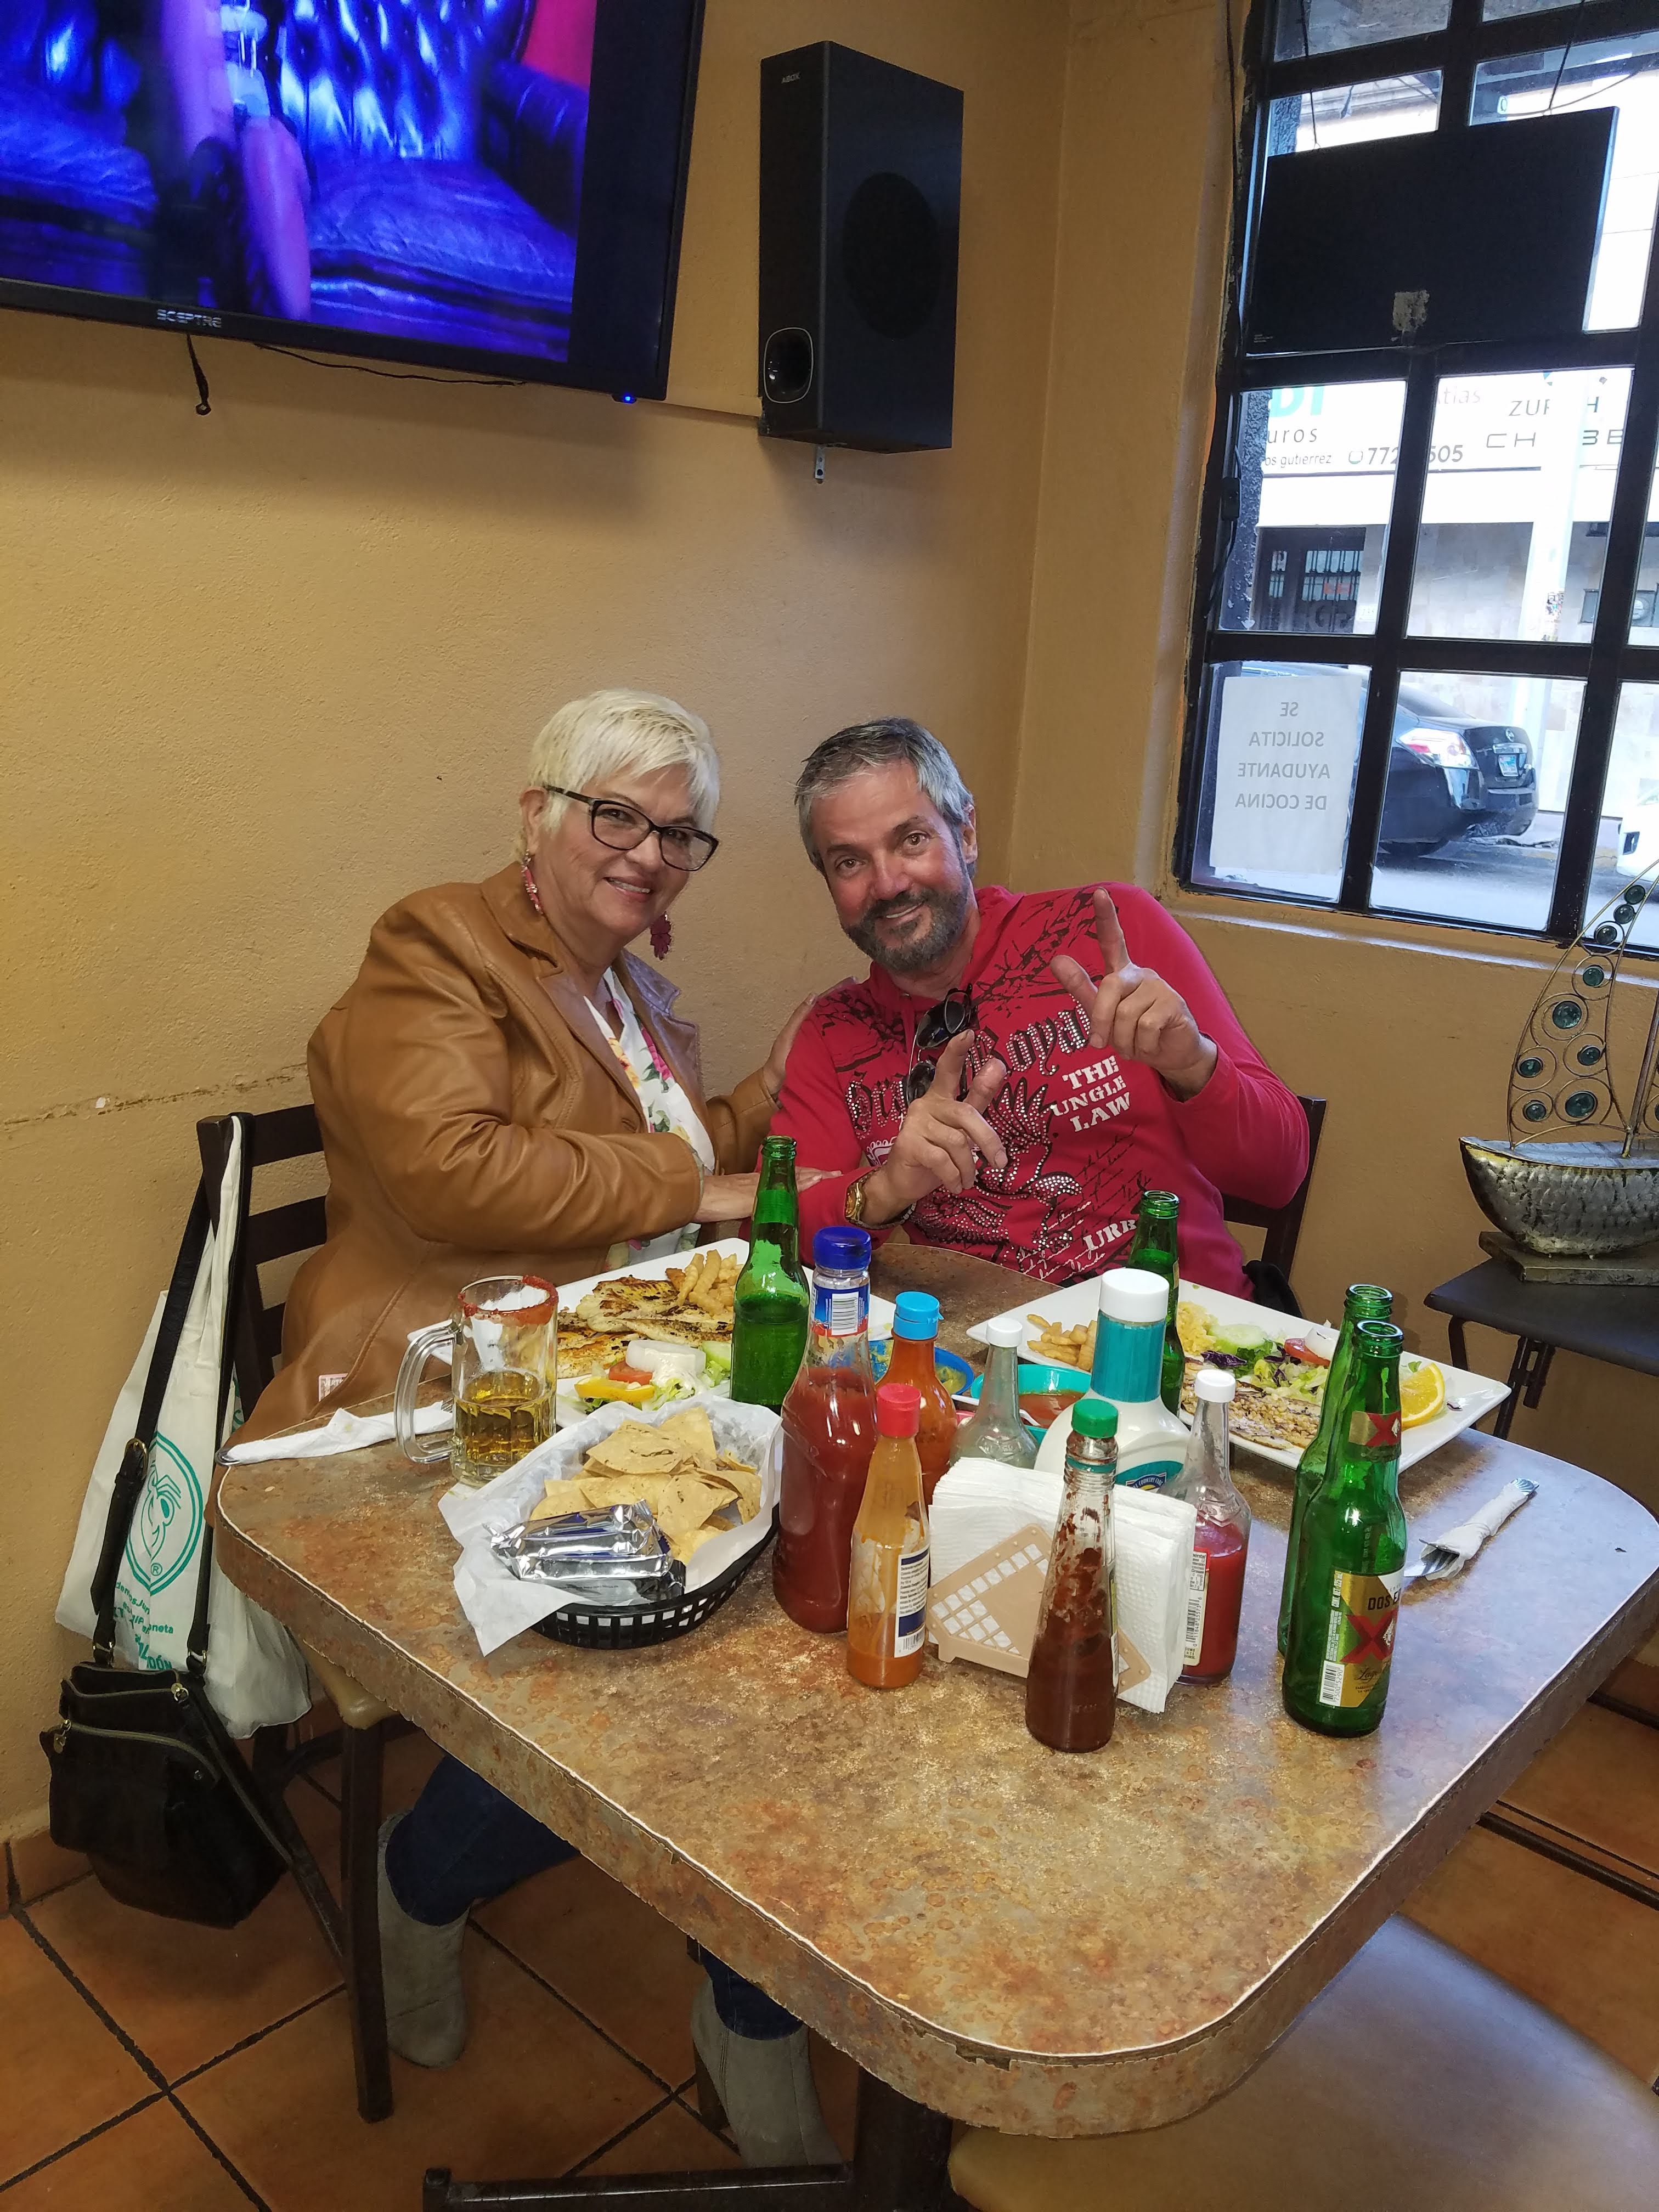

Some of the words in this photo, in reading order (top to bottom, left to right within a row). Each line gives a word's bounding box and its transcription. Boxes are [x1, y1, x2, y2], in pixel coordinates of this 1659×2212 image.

[157, 309, 222, 328] SCEPTRE
[1280, 454, 1332, 468] gutierrez
[1062, 1054, 1120, 1090] THE
[1070, 1092, 1130, 1132] LAW
[1368, 1594, 1391, 1611] DOS
